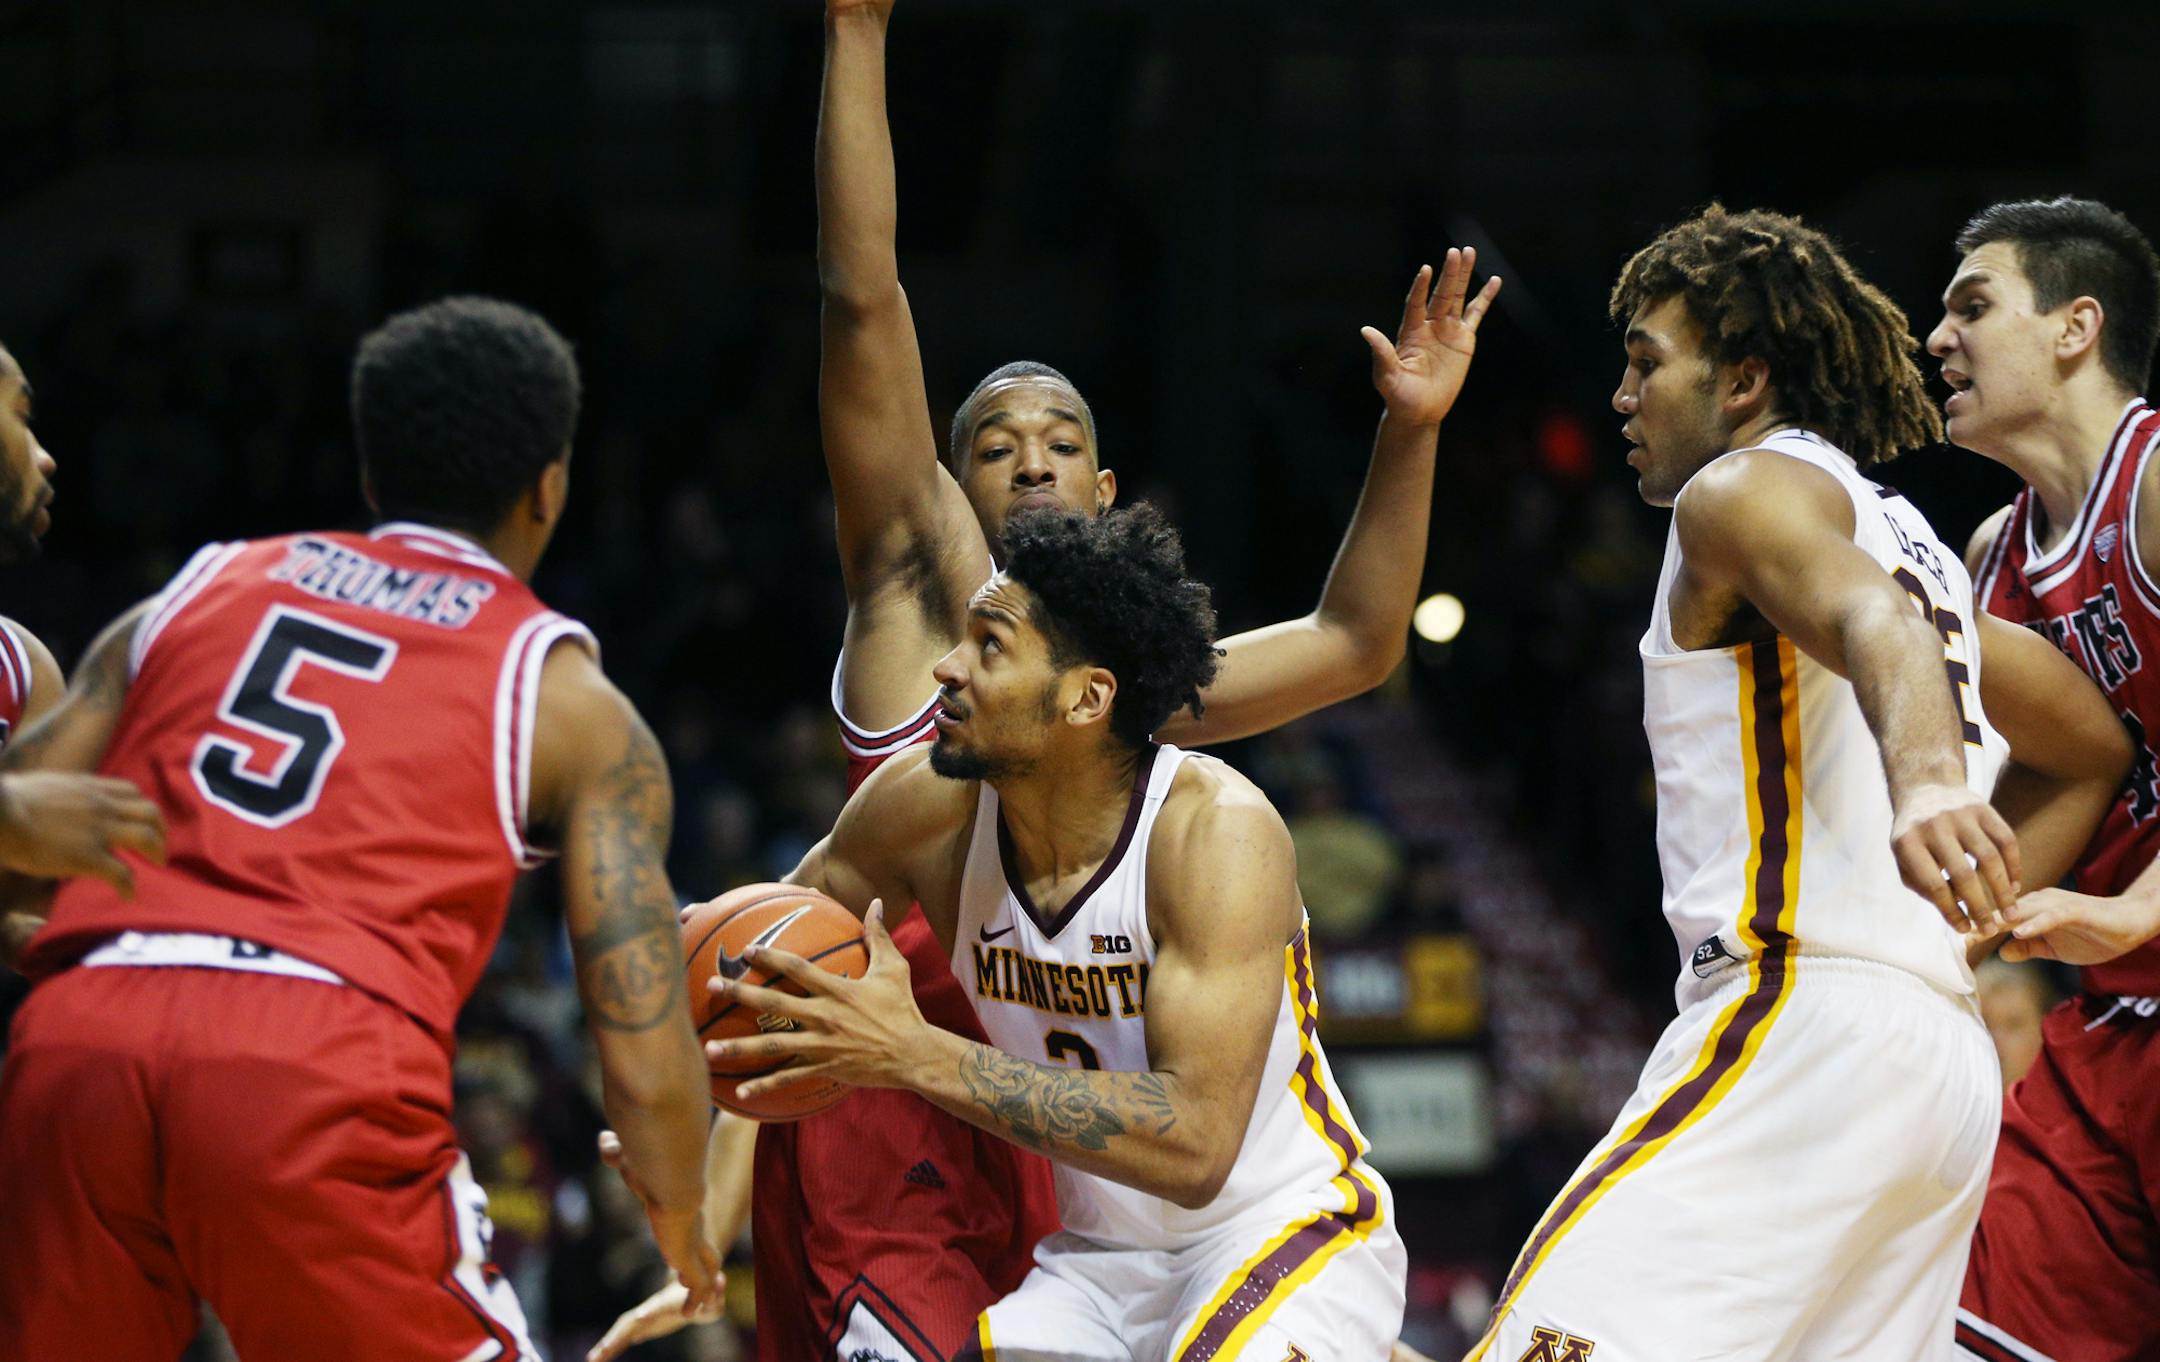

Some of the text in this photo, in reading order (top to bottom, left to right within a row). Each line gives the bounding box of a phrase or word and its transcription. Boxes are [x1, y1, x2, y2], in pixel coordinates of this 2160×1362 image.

[266, 534, 496, 631] THOMAS
[190, 604, 398, 829] 5
[1697, 944, 1716, 960] 52
